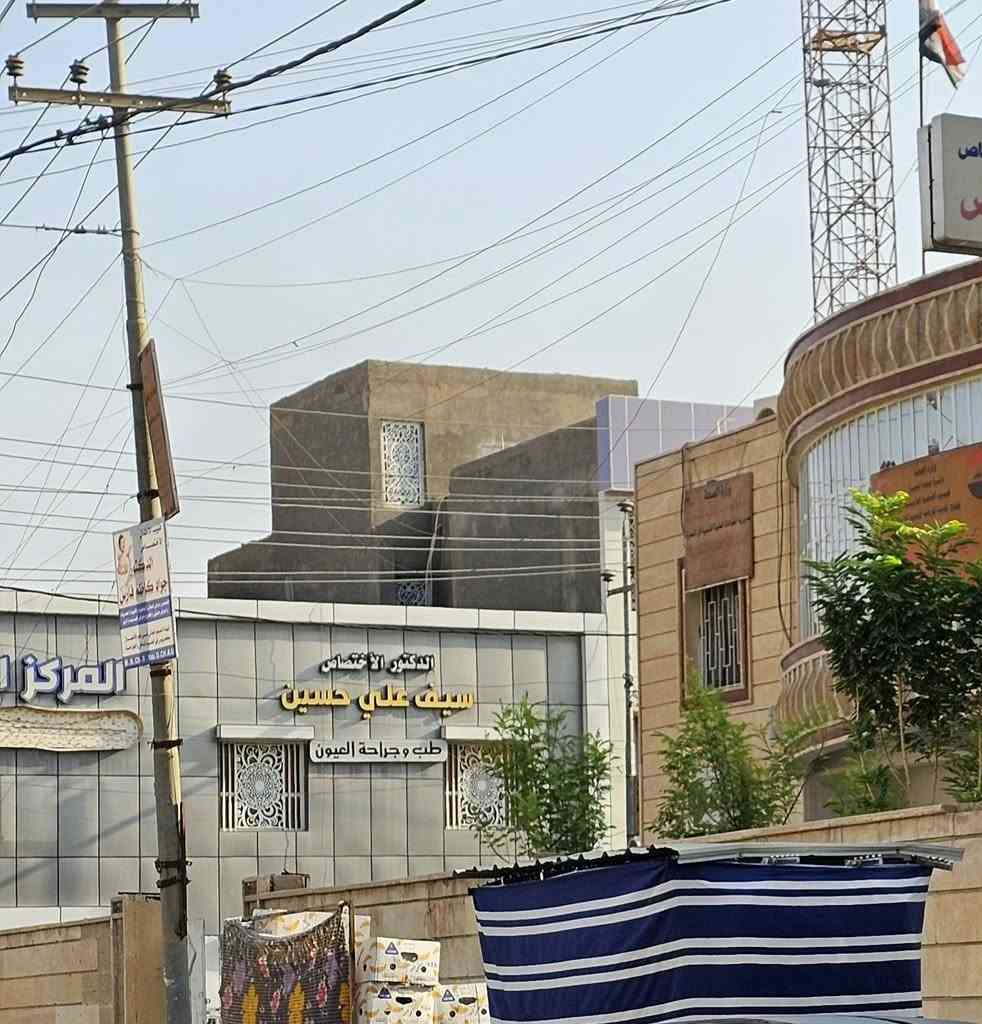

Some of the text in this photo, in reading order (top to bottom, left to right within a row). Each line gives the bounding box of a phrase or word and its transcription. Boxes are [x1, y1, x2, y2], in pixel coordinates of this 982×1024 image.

[389, 652, 435, 674] الدكتور
[20, 654, 126, 704] المركز
[280, 683, 474, 720] سيف علي حسين
[315, 741, 355, 760] العيون
[414, 741, 442, 759] طب
